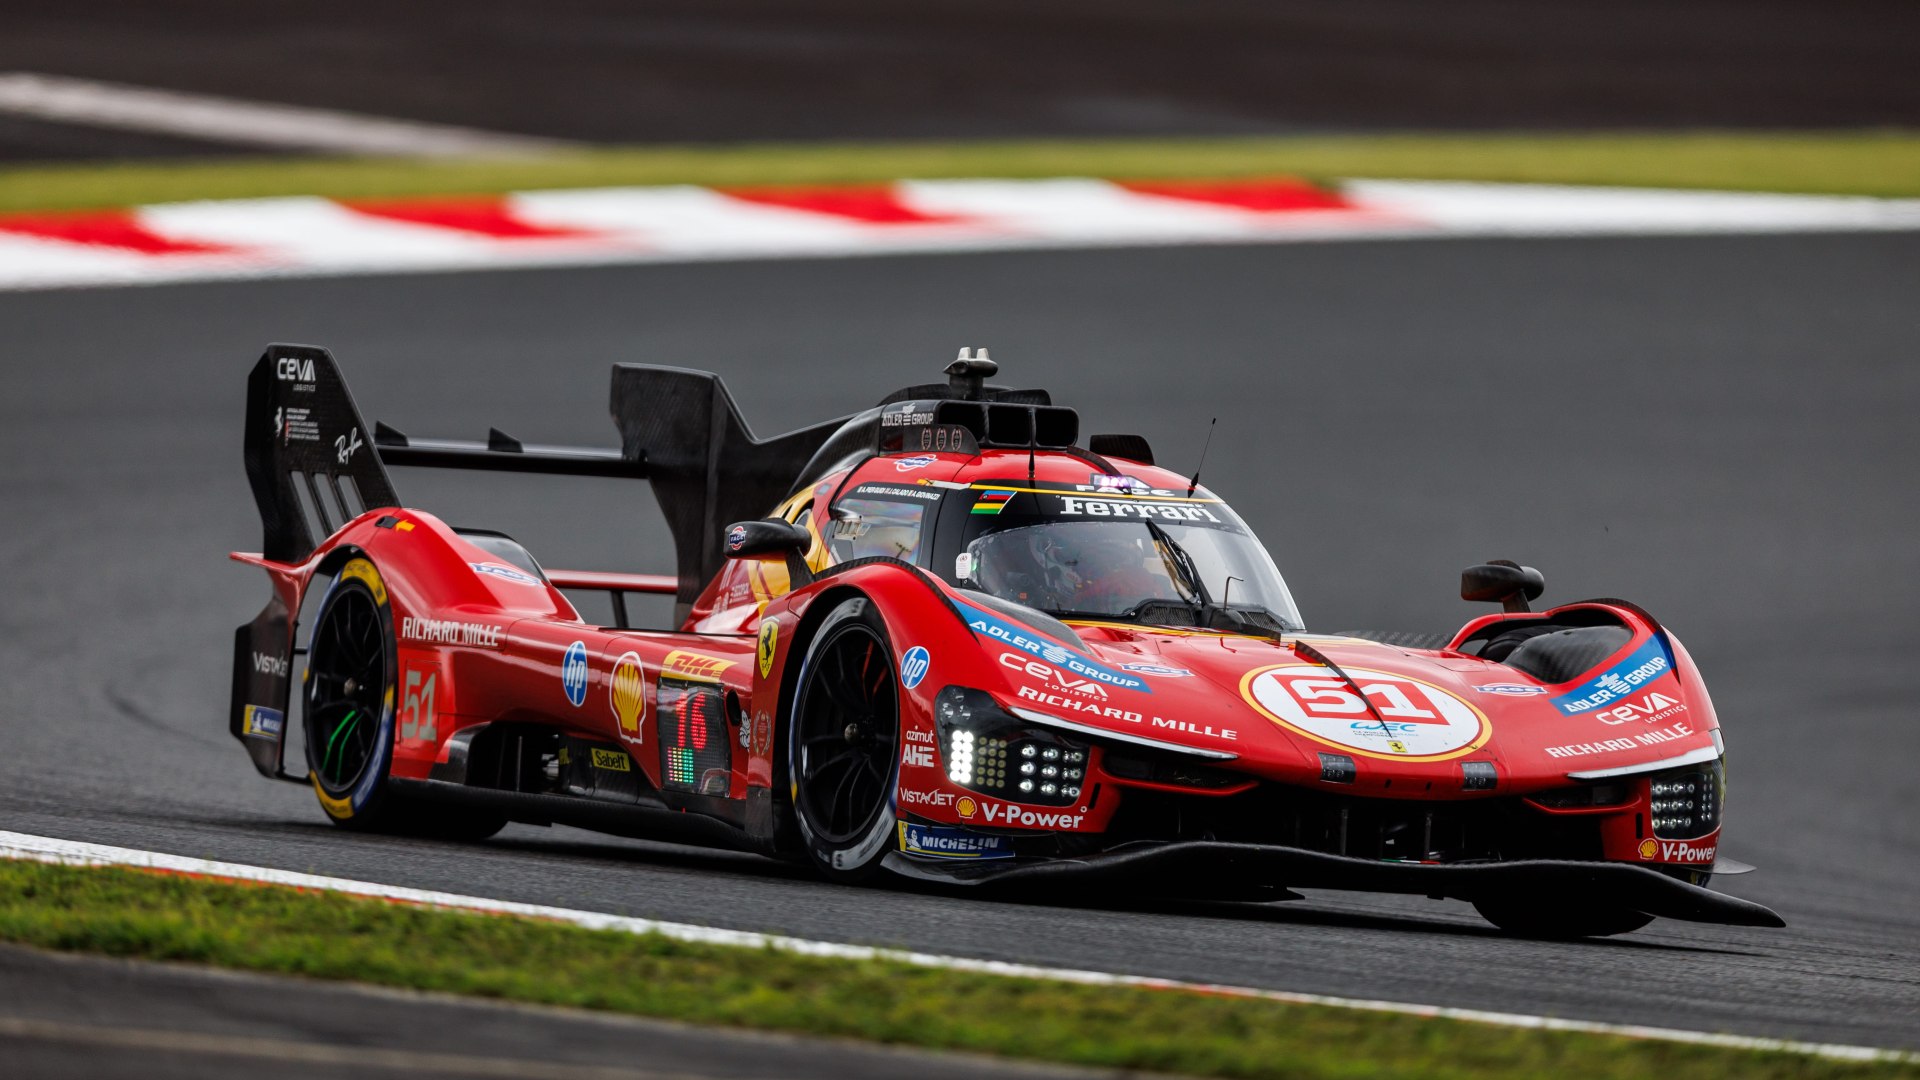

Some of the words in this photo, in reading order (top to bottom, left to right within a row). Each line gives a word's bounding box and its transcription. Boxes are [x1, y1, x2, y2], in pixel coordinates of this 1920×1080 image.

[881, 412, 903, 427] ADLER
[911, 412, 934, 425] GROUP
[1061, 496, 1221, 523] Ferrari
[402, 616, 460, 644] RICHARD
[462, 622, 502, 647] MILLE
[671, 655, 719, 677] DHL
[902, 647, 929, 688] hp
[969, 620, 1041, 652] ADLER
[1068, 660, 1140, 688] GROUP
[565, 643, 586, 706] hp
[1563, 689, 1617, 713] ADLER
[1624, 656, 1667, 686] GROUP
[402, 669, 438, 741] 51
[1044, 682, 1108, 702] LOGISTICS
[1290, 679, 1437, 719] 51
[675, 692, 708, 750] 16
[1018, 686, 1143, 723] RICHARD
[1151, 716, 1238, 741] MILLE
[1644, 704, 1687, 724] LOGISTICS
[906, 725, 934, 744] azimut
[1544, 737, 1638, 758] RICHARD
[1634, 722, 1694, 746] MILLE
[595, 750, 626, 770] Sabelt
[900, 788, 955, 806] VISTAJET
[981, 802, 1084, 829] V-Power
[922, 836, 1000, 850] MICHELIN
[1662, 842, 1716, 862] V-Power
